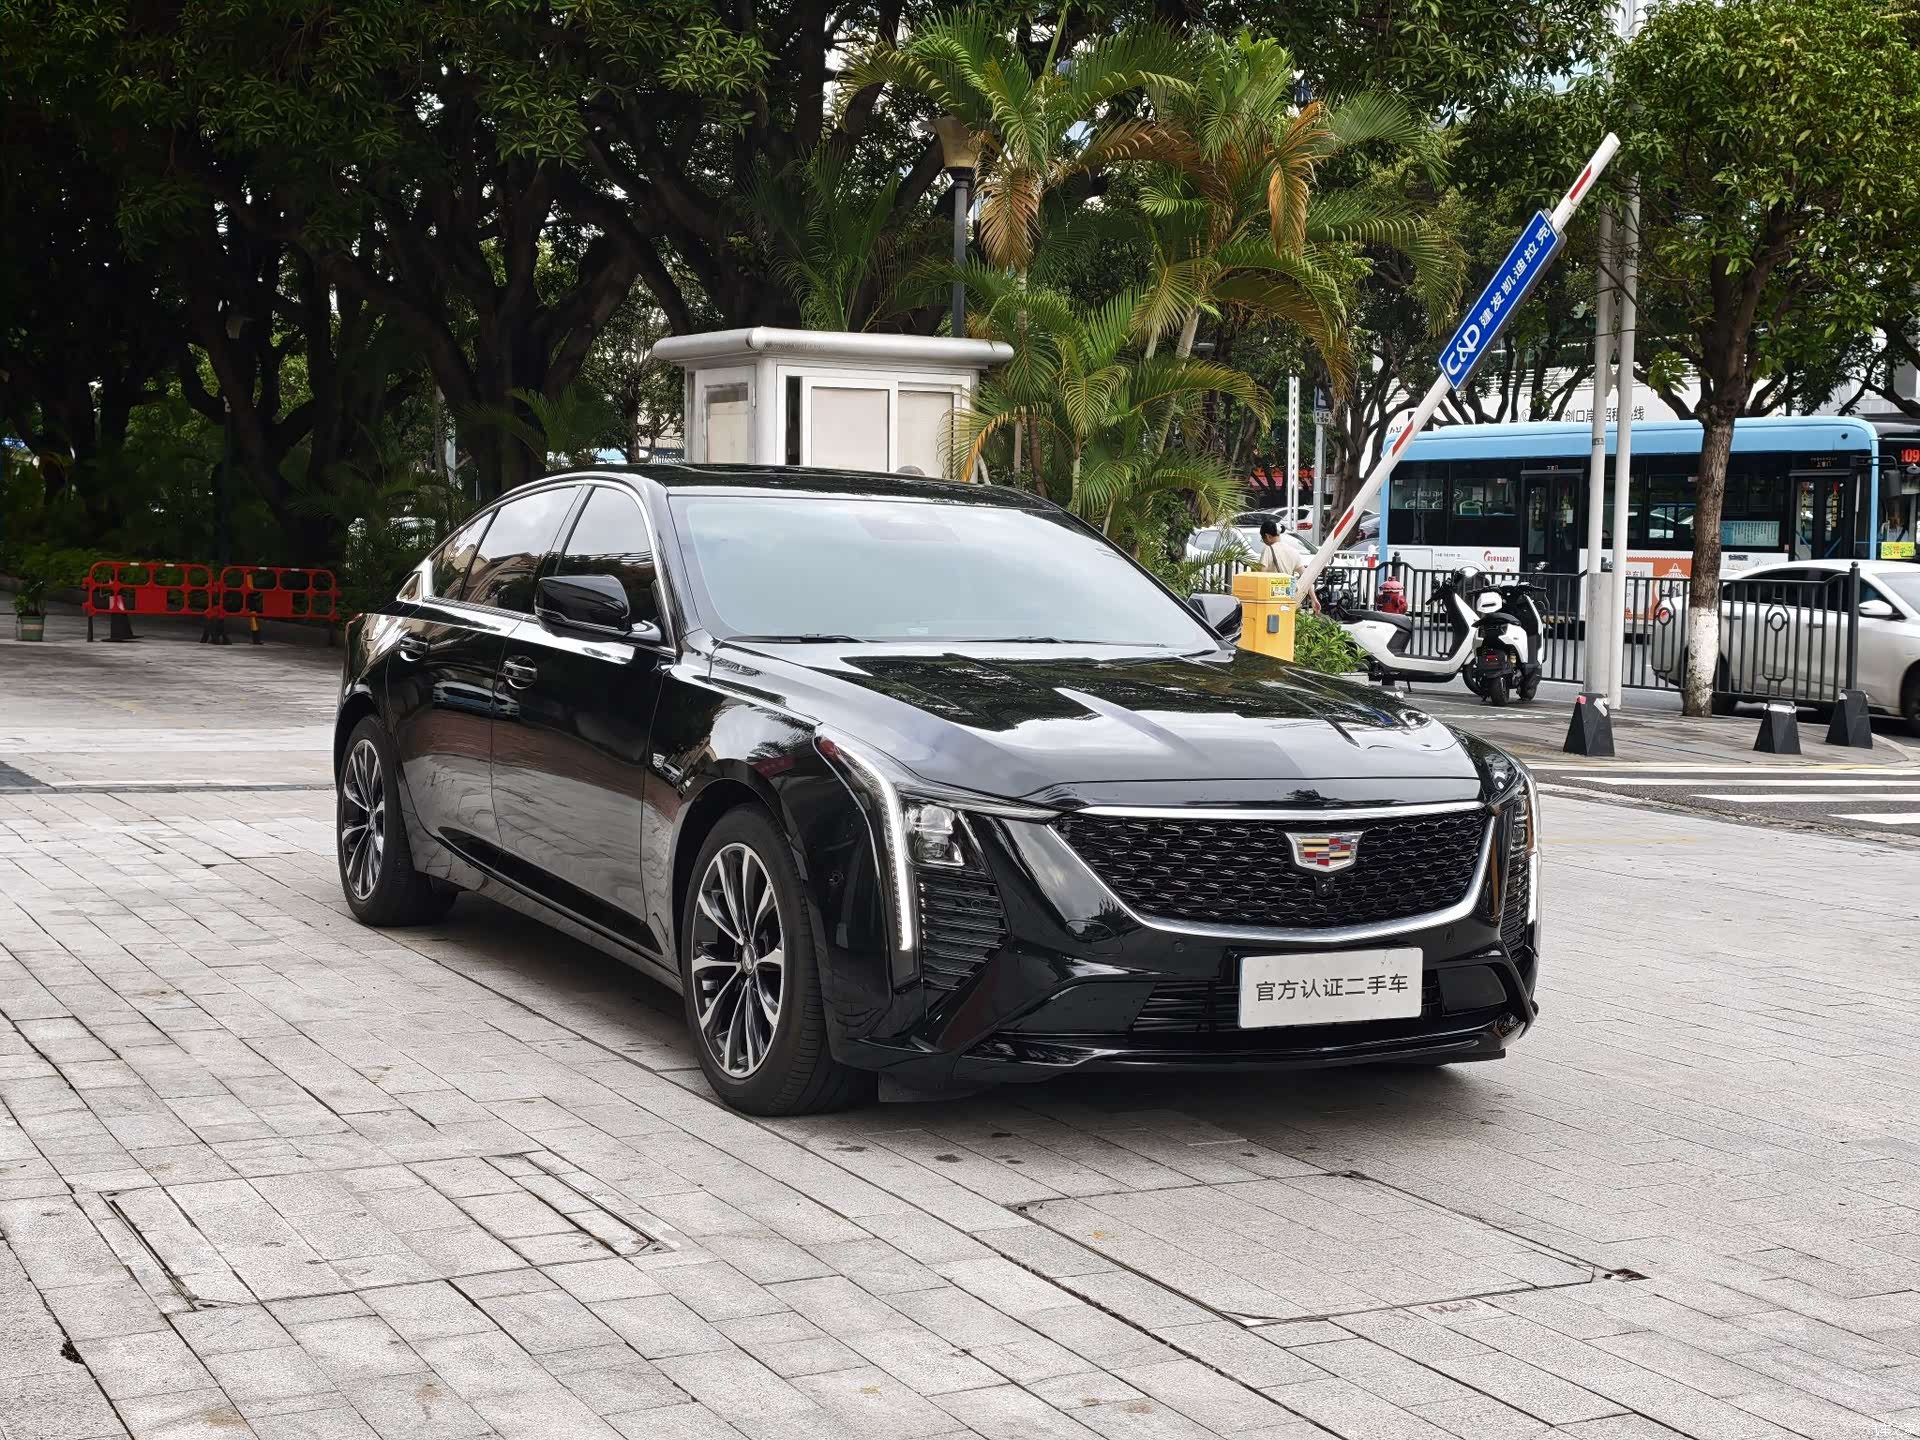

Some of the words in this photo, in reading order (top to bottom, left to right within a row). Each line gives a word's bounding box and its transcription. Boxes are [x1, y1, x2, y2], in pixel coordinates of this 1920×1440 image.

[1445, 323, 1481, 376] C&D
[1478, 223, 1551, 329] 建发凯迪拉克
[1256, 973, 1409, 1002] 官方认证二手车
